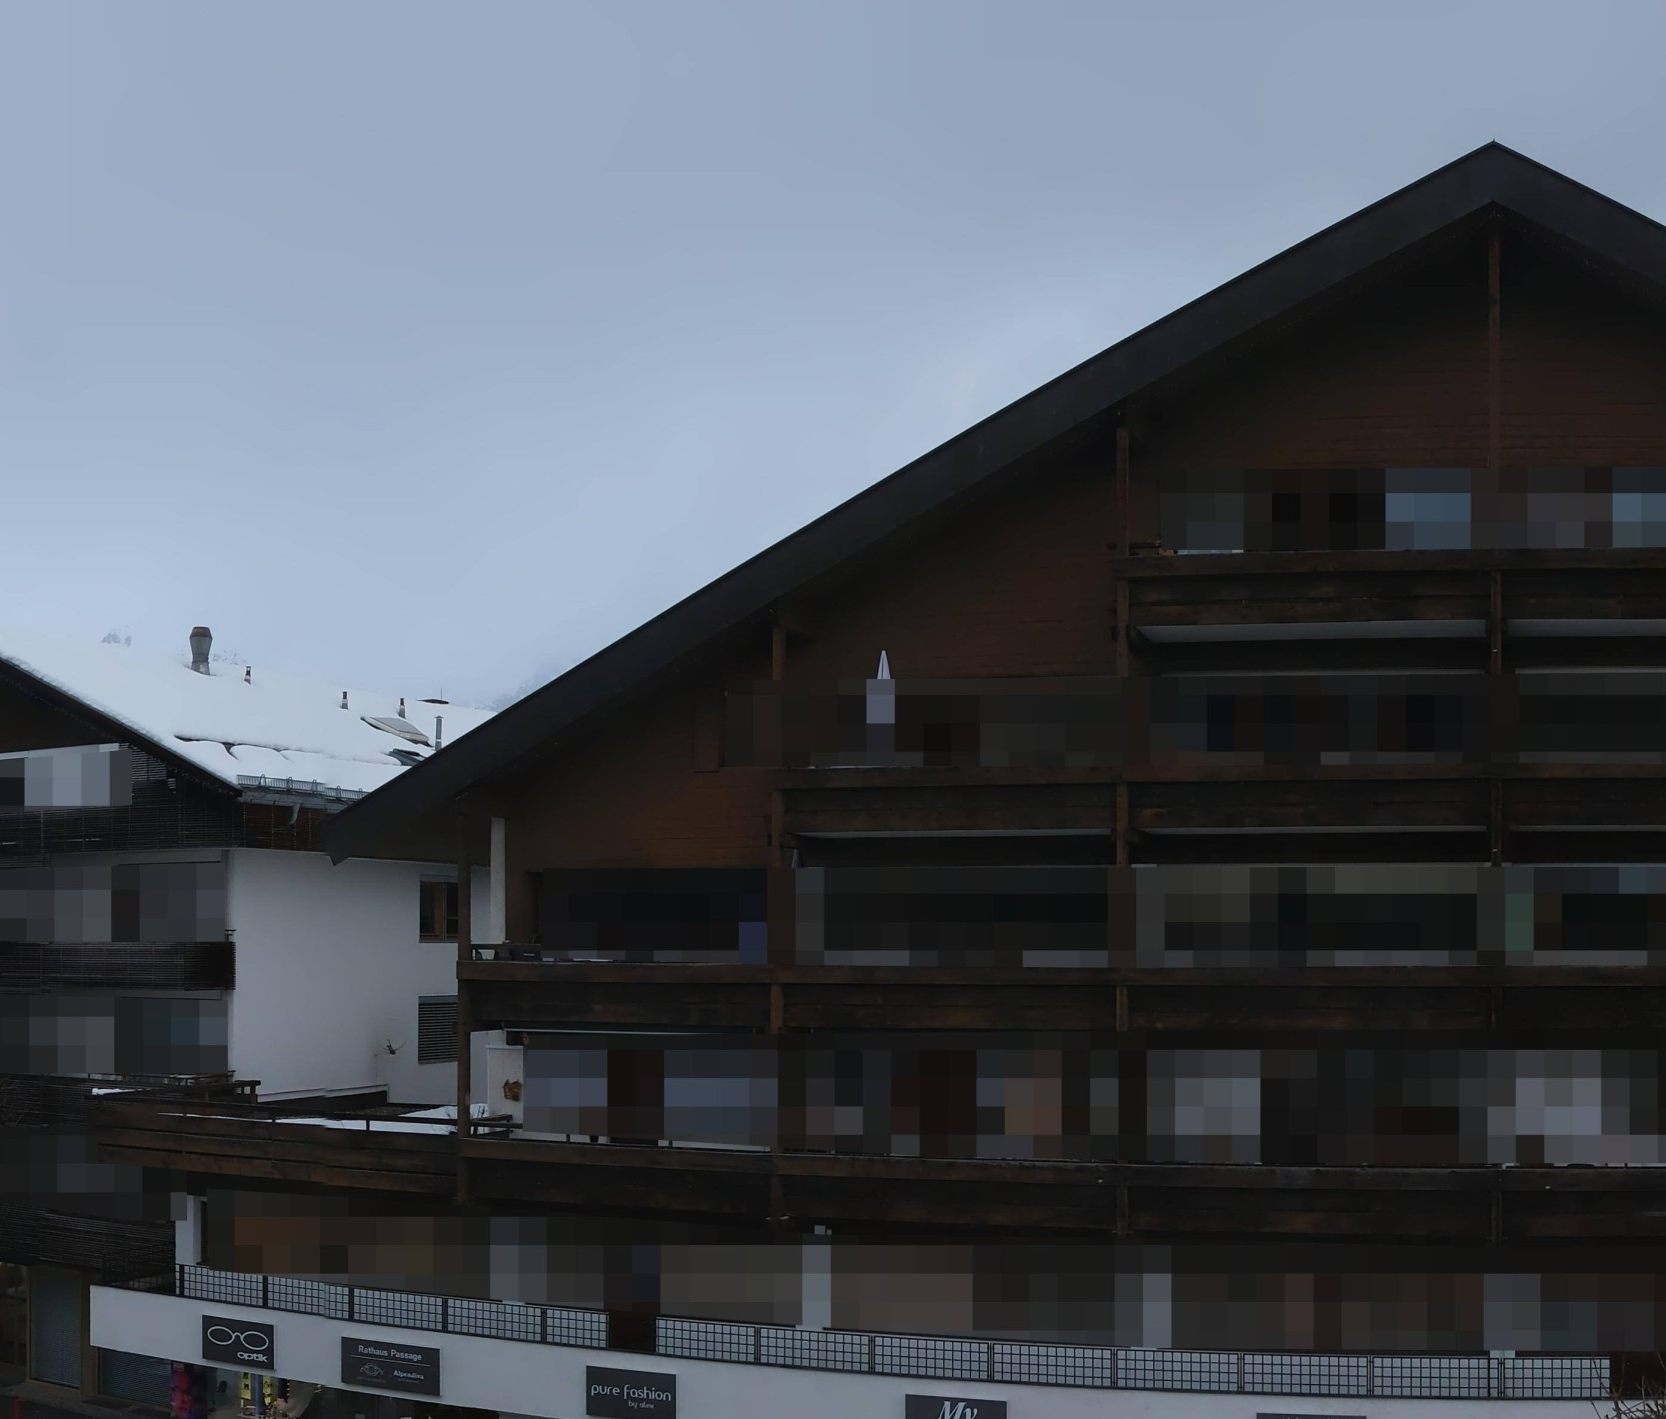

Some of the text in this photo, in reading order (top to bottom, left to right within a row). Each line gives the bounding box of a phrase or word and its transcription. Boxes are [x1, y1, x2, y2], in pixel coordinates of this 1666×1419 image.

[237, 1351, 268, 1363] optik
[358, 1344, 422, 1362] Rathaus Passage
[591, 1384, 672, 1401] pure fashion
[628, 1400, 638, 1408] by
